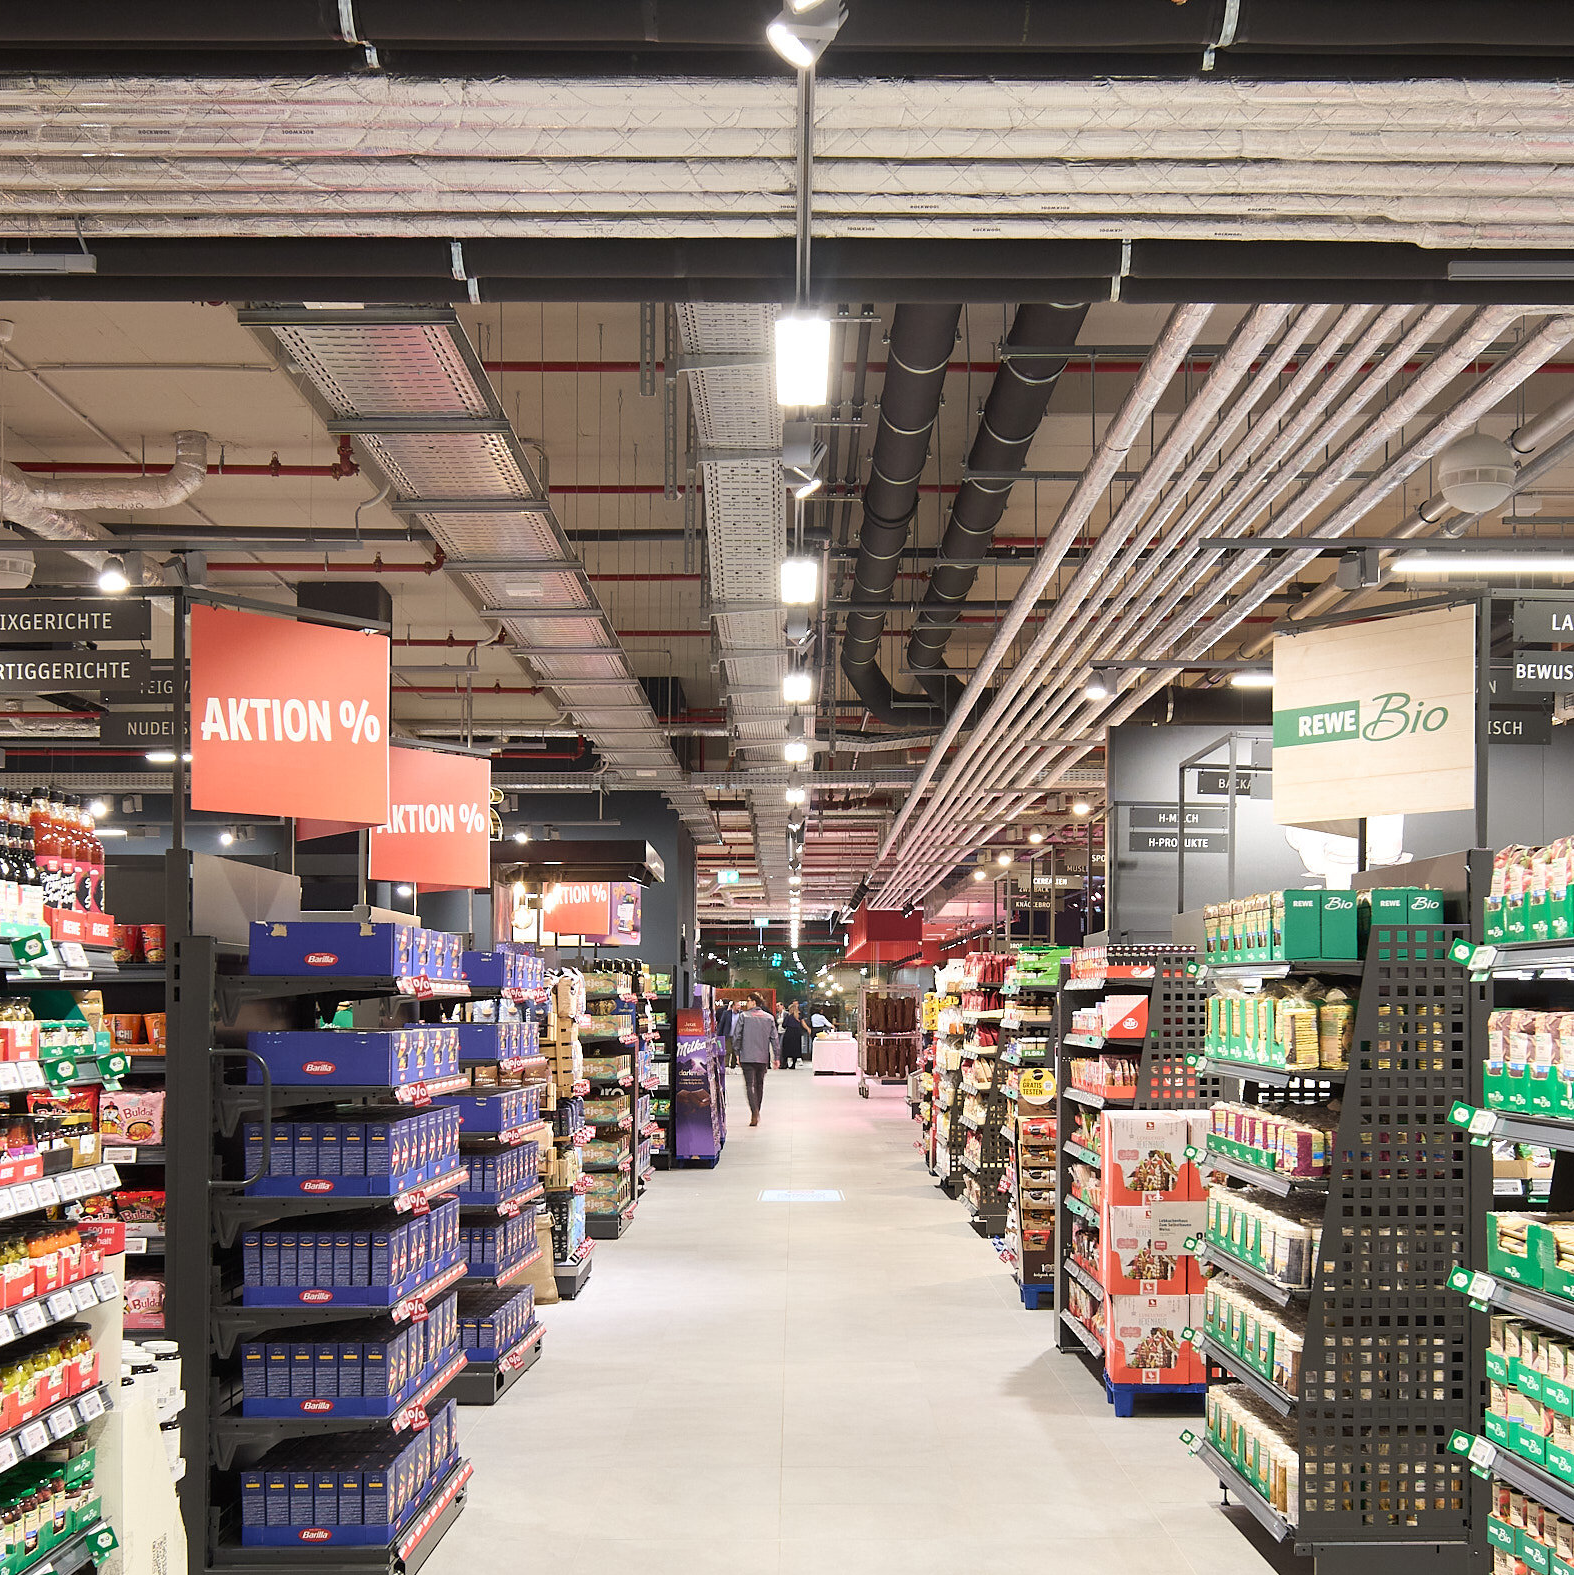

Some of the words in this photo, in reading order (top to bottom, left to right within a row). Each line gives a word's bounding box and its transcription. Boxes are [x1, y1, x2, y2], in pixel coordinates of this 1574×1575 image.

[201, 697, 332, 742] AKTION
[340, 699, 381, 744] %
[1298, 709, 1356, 738] REWE
[1362, 692, 1449, 742] Bio
[459, 803, 484, 833] %
[1159, 814, 1199, 824] H-MCH
[1149, 838, 1209, 848] H-PROUKTE
[1293, 900, 1314, 908] REWE
[1325, 897, 1353, 911] Bio
[1380, 899, 1401, 907] REWE
[1411, 897, 1439, 911] Bio
[63, 920, 81, 936] REWE
[677, 1039, 707, 1057] Milka
[1022, 1081, 1042, 1089] GRATIS
[123, 1106, 154, 1122] Buldak
